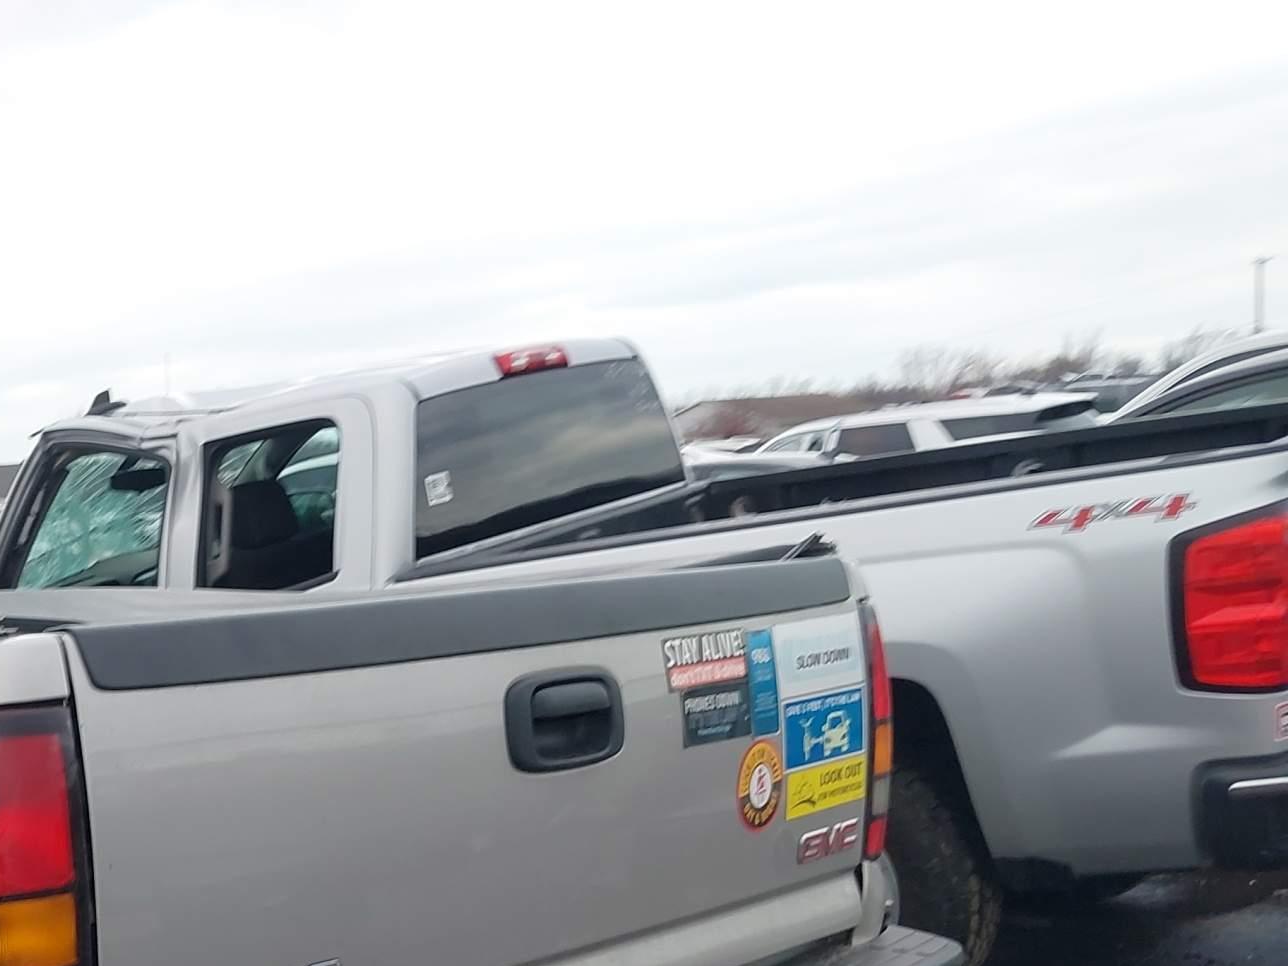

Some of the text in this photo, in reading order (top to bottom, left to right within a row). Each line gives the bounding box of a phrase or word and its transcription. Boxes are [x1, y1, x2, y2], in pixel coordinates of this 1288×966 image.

[665, 629, 745, 668] STAY ALIVE!
[796, 647, 849, 671] SLOW DOWN
[819, 760, 863, 787] LOOK OUT
[797, 818, 859, 865] GMC
